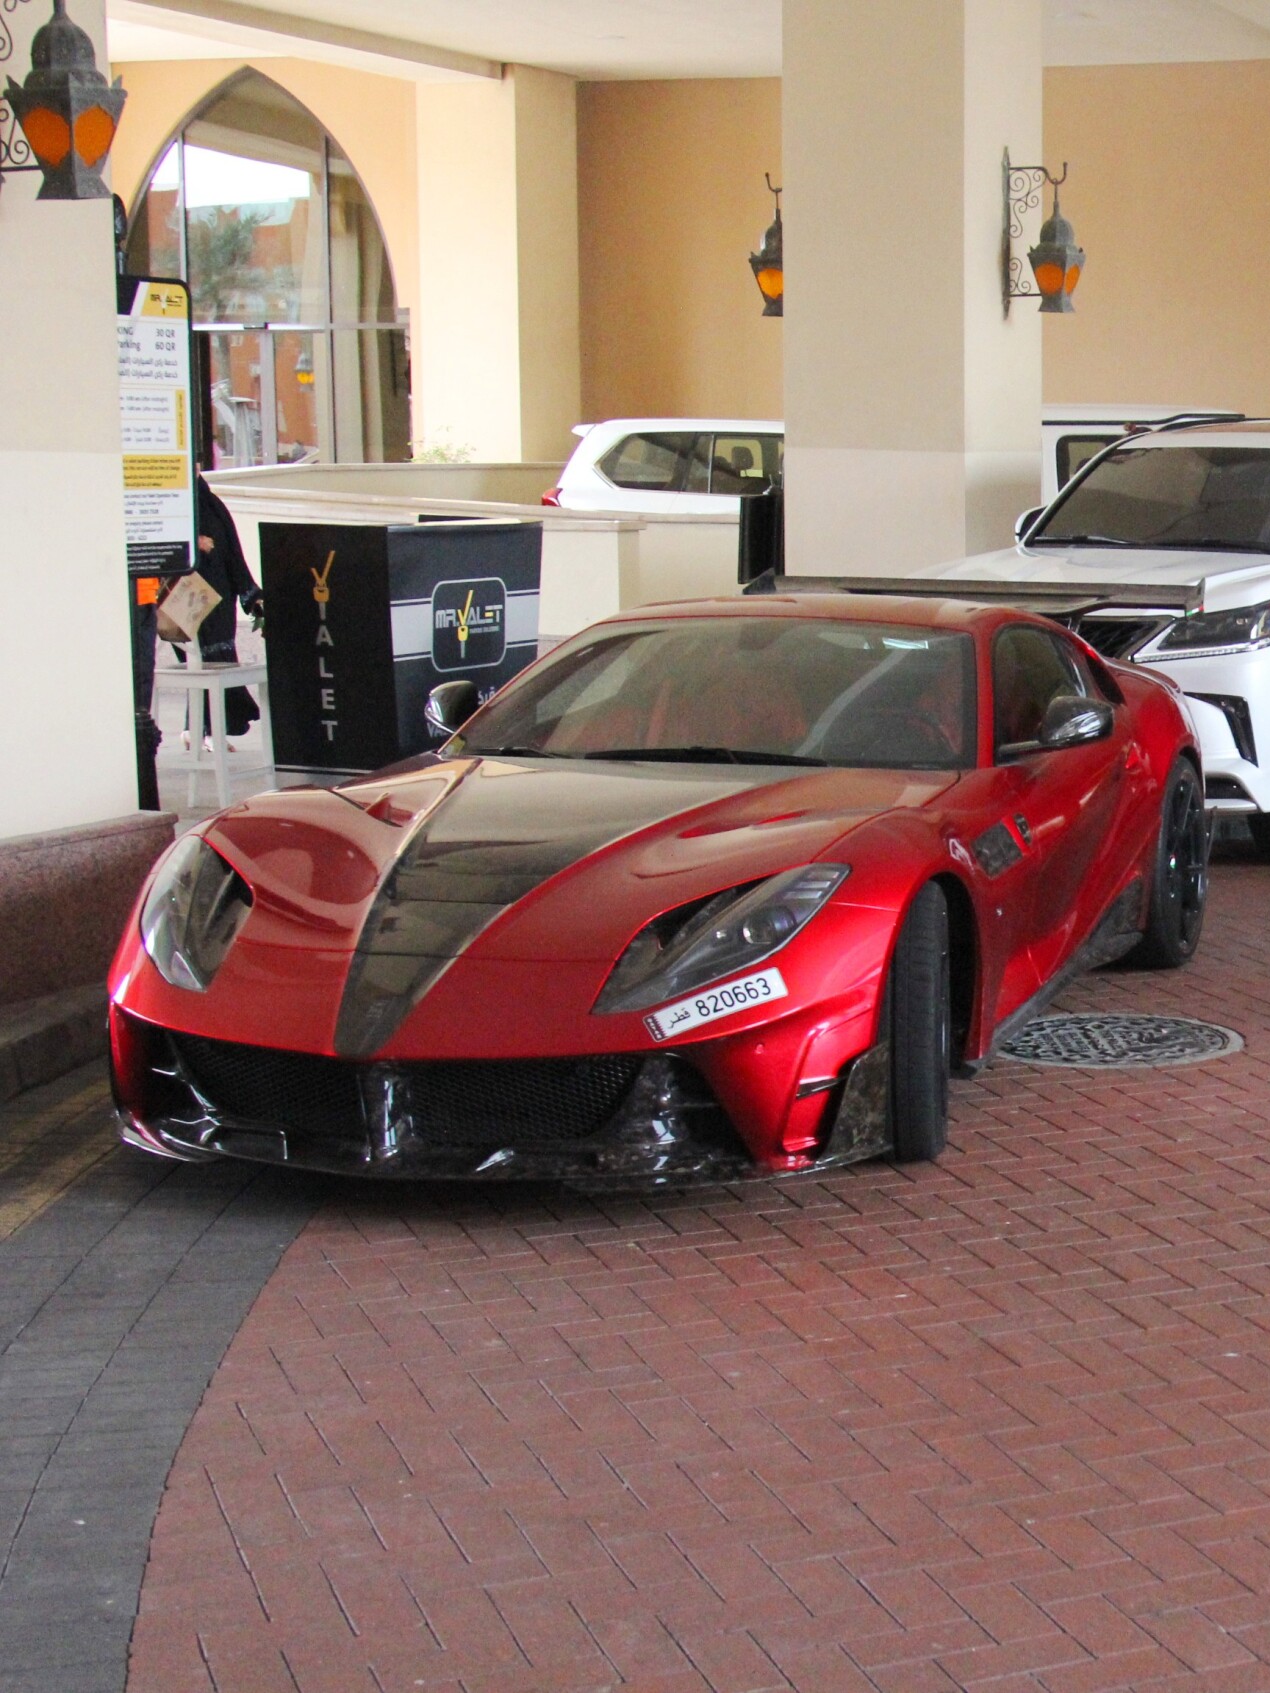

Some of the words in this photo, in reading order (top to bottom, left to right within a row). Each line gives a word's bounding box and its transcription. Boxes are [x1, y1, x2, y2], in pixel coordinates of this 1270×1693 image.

[156, 328, 164, 337] 30
[165, 328, 175, 338] QR
[155, 341, 164, 350] 60
[165, 341, 175, 351] QR
[695, 977, 771, 1017] 820663
[667, 1007, 691, 1029] قطر
